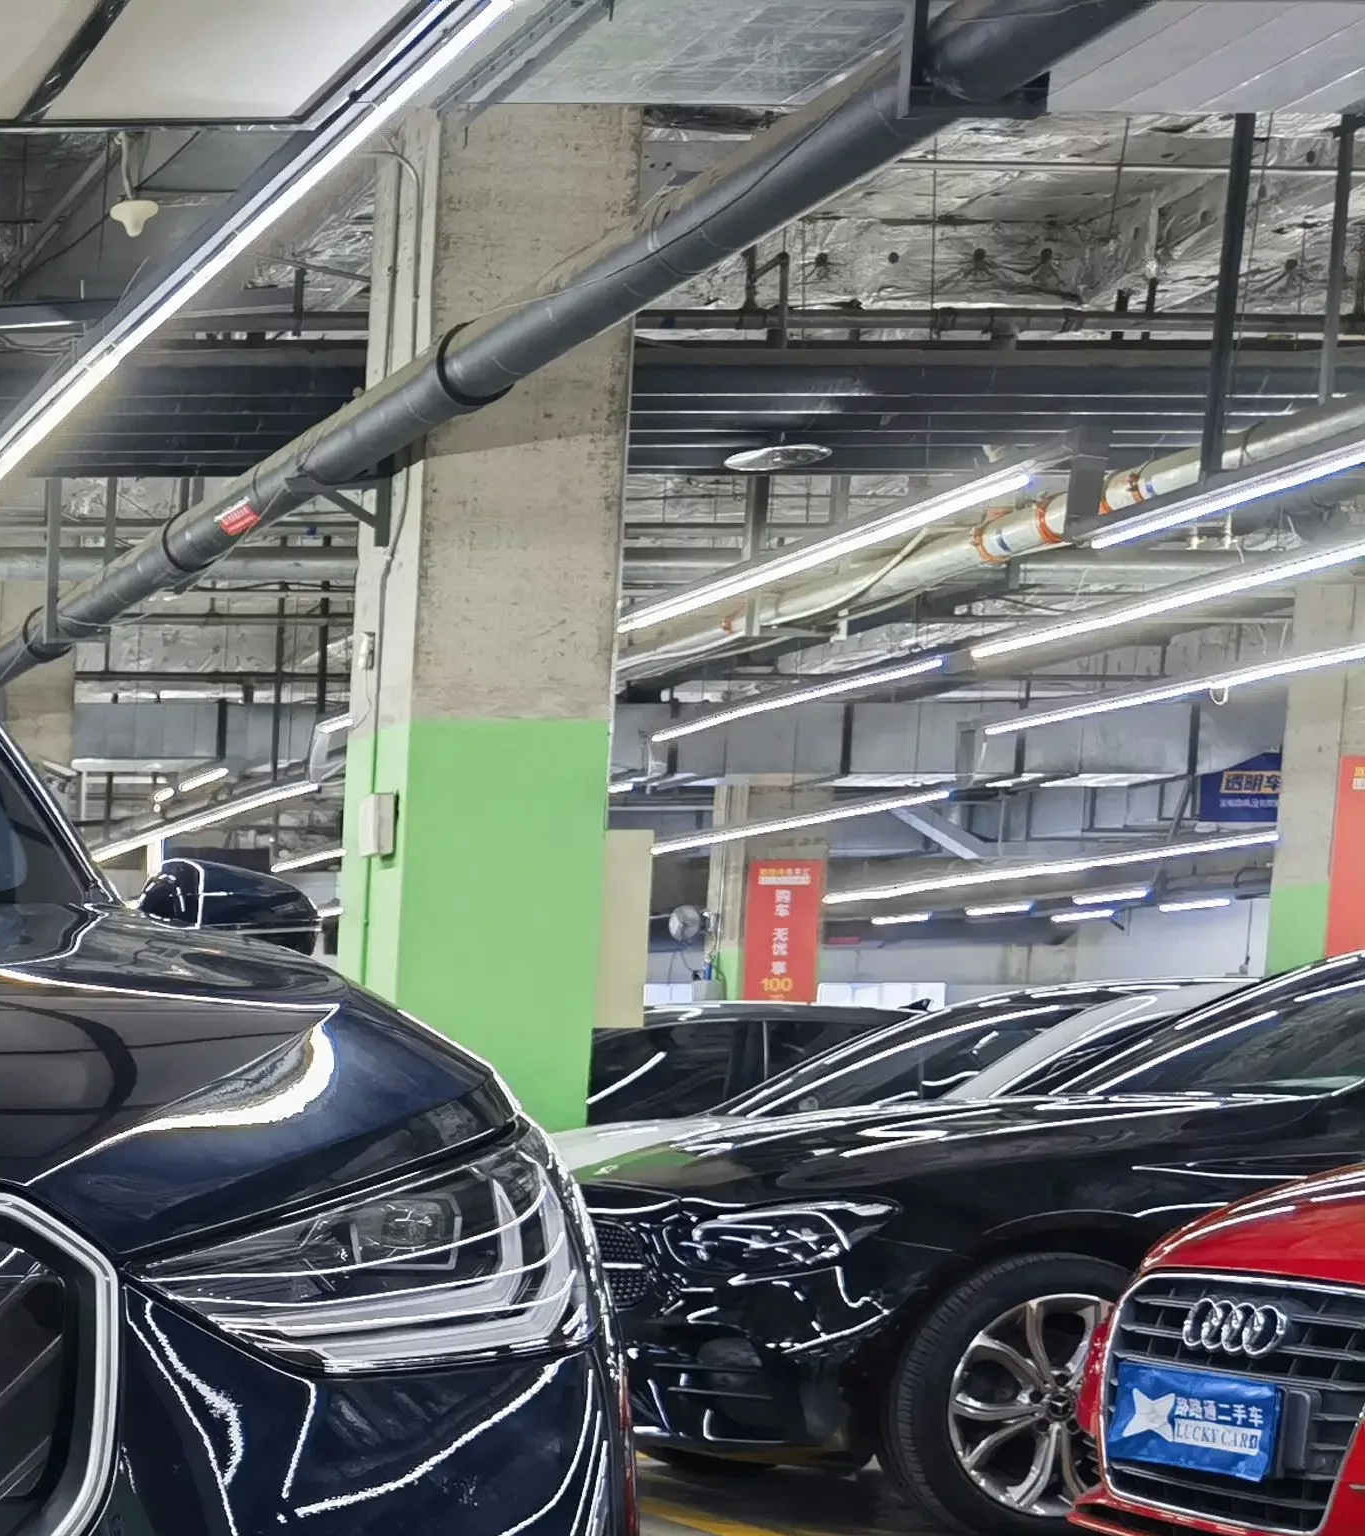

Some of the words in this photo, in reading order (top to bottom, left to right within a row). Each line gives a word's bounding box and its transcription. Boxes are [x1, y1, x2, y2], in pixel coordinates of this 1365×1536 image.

[760, 977, 793, 992] 100
[1174, 1396, 1264, 1427] 路路通二手车
[1176, 1422, 1216, 1442] LUCKY
[1221, 1430, 1249, 1448] CAR
